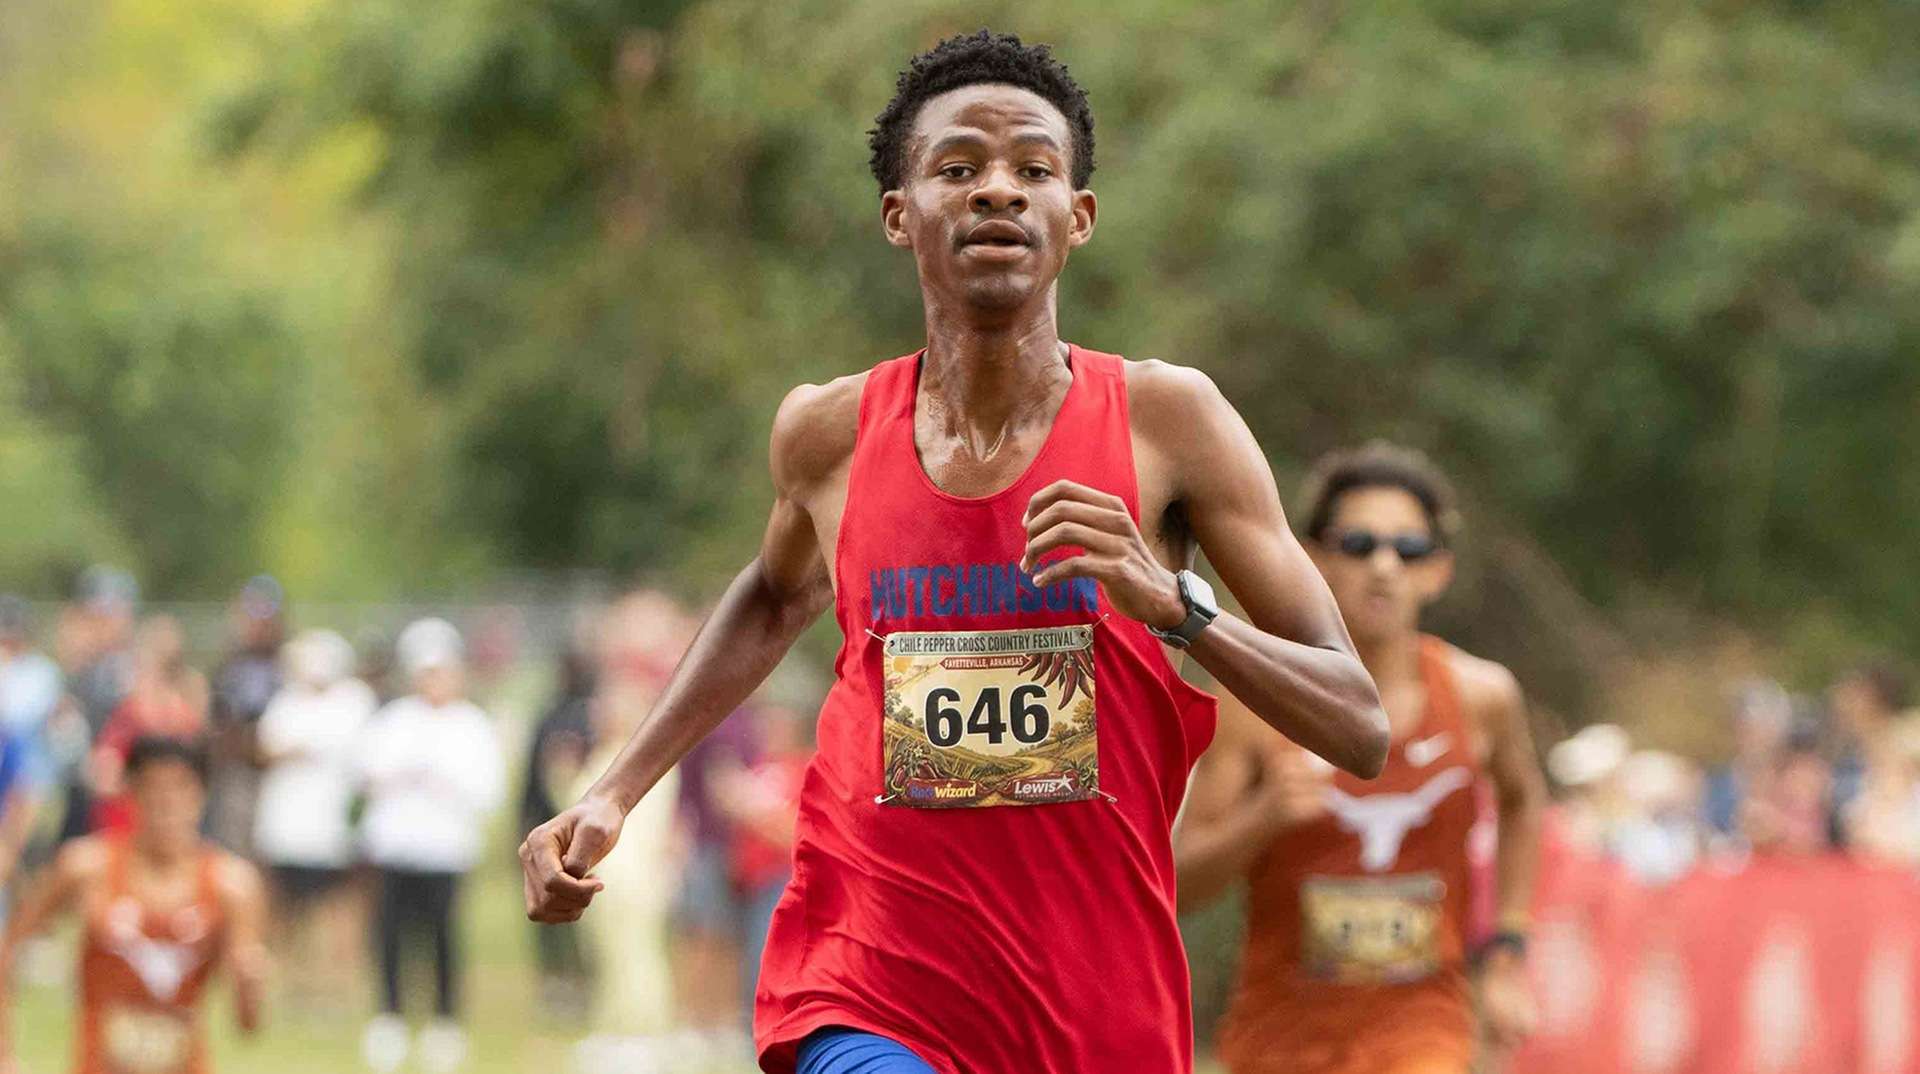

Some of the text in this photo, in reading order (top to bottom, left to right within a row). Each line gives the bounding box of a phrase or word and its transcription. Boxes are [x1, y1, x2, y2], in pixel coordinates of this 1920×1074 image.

[870, 561, 1098, 620] HUTCHINSON
[899, 632, 1076, 653] CHILE PEPPER CROSS COUNTRY FESTIVAL
[990, 656, 1024, 667] ARKANSAS
[926, 686, 1050, 747] 646
[1014, 781, 1057, 794] Lewis
